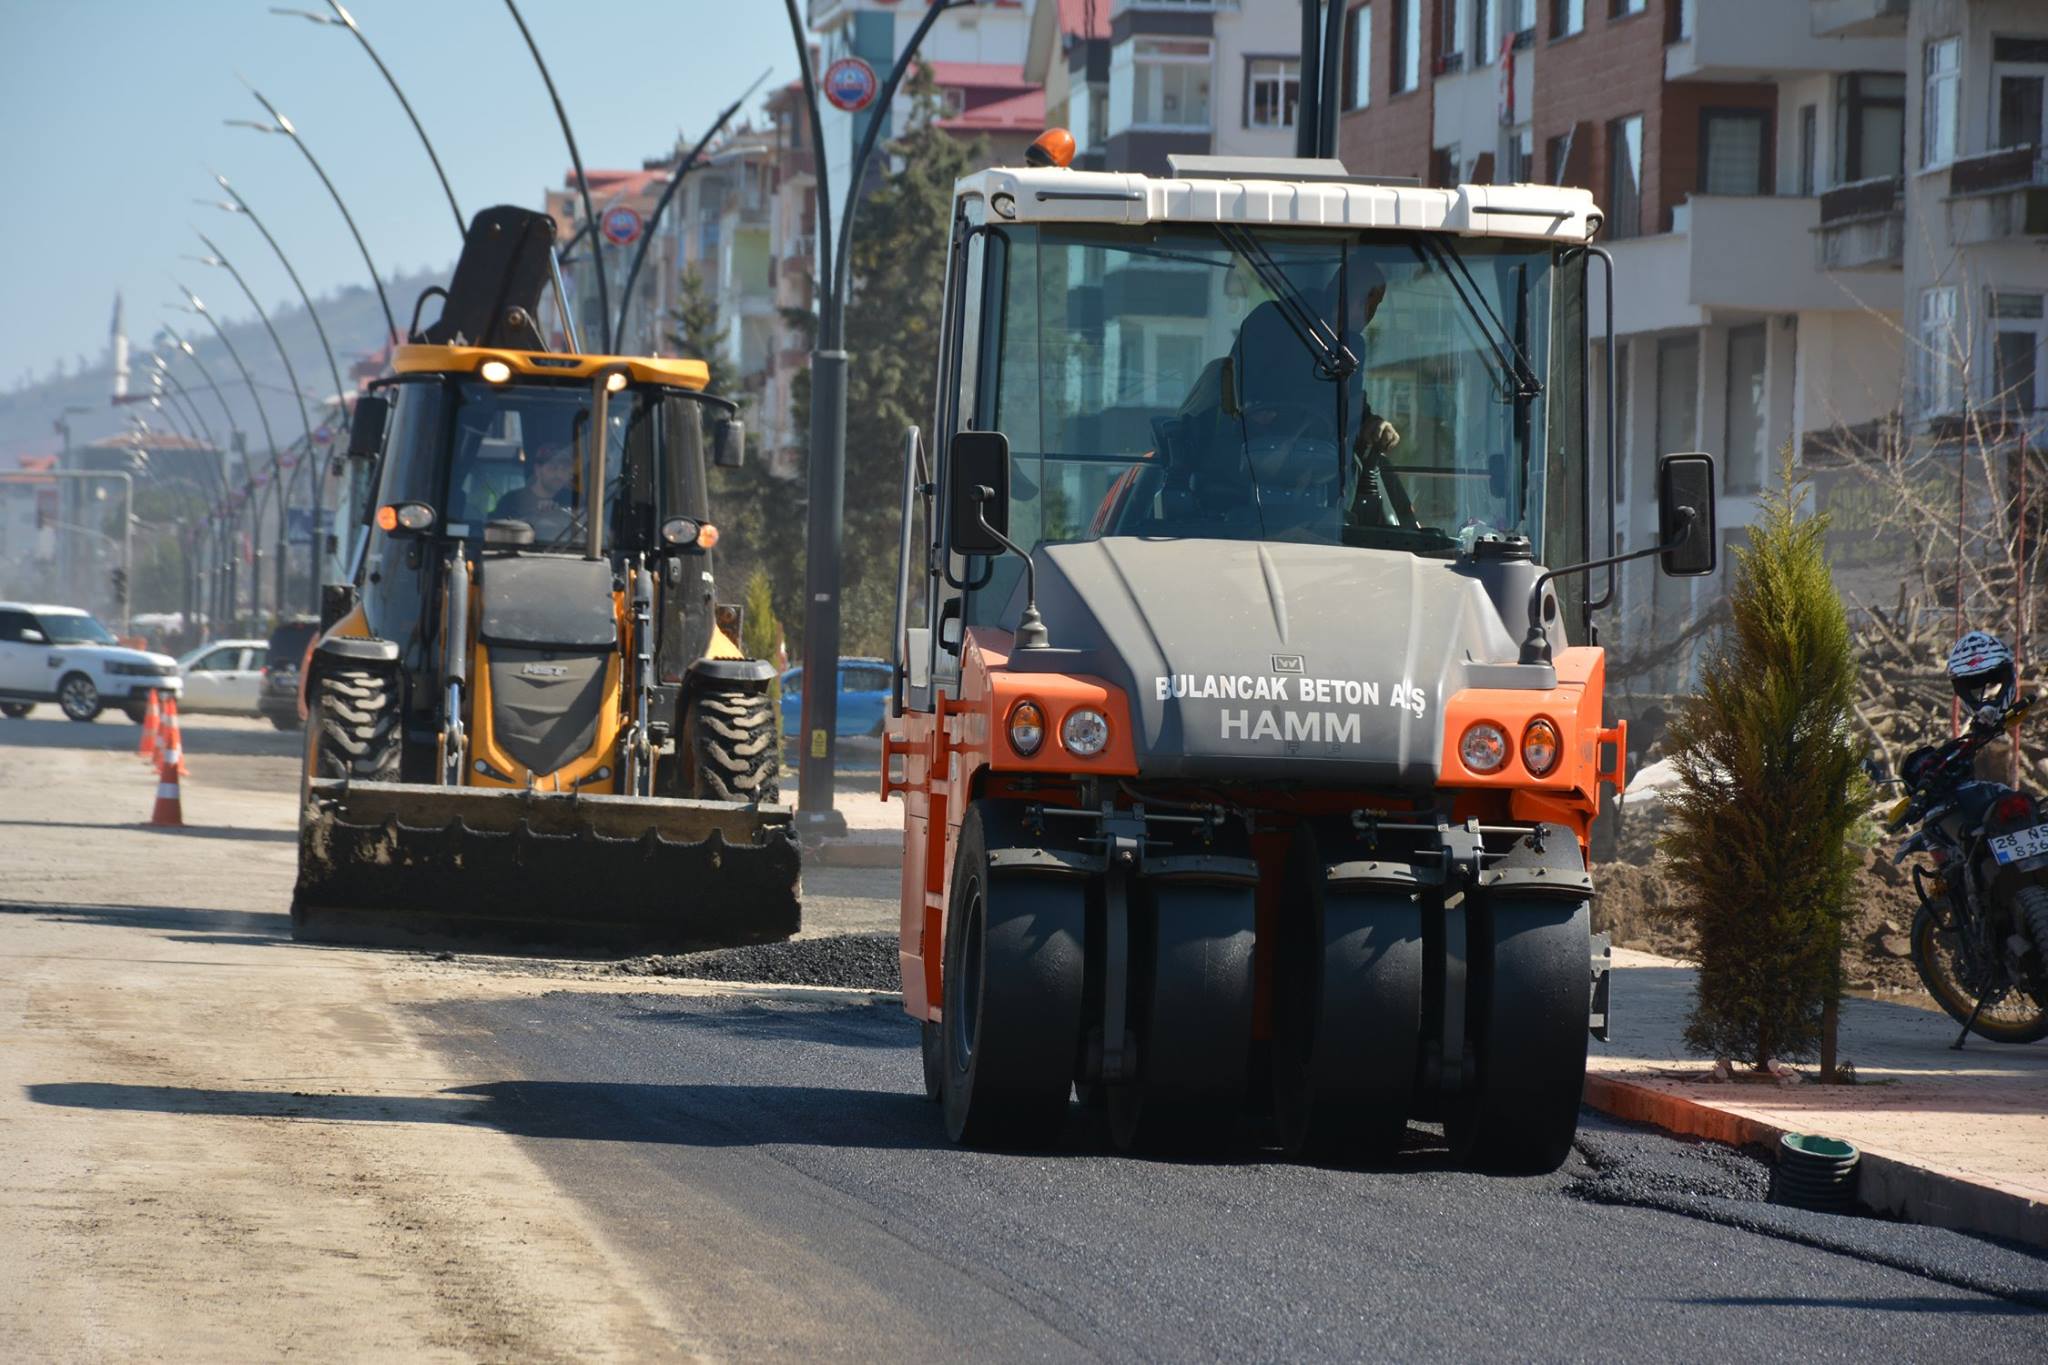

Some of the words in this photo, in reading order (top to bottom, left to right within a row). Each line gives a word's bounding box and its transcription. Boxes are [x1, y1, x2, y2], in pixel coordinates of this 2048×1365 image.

[1155, 674, 1289, 701] BULANCAK
[1299, 678, 1380, 706] BETON
[1220, 708, 1361, 744] HAMM
[1995, 834, 2018, 850] 28
